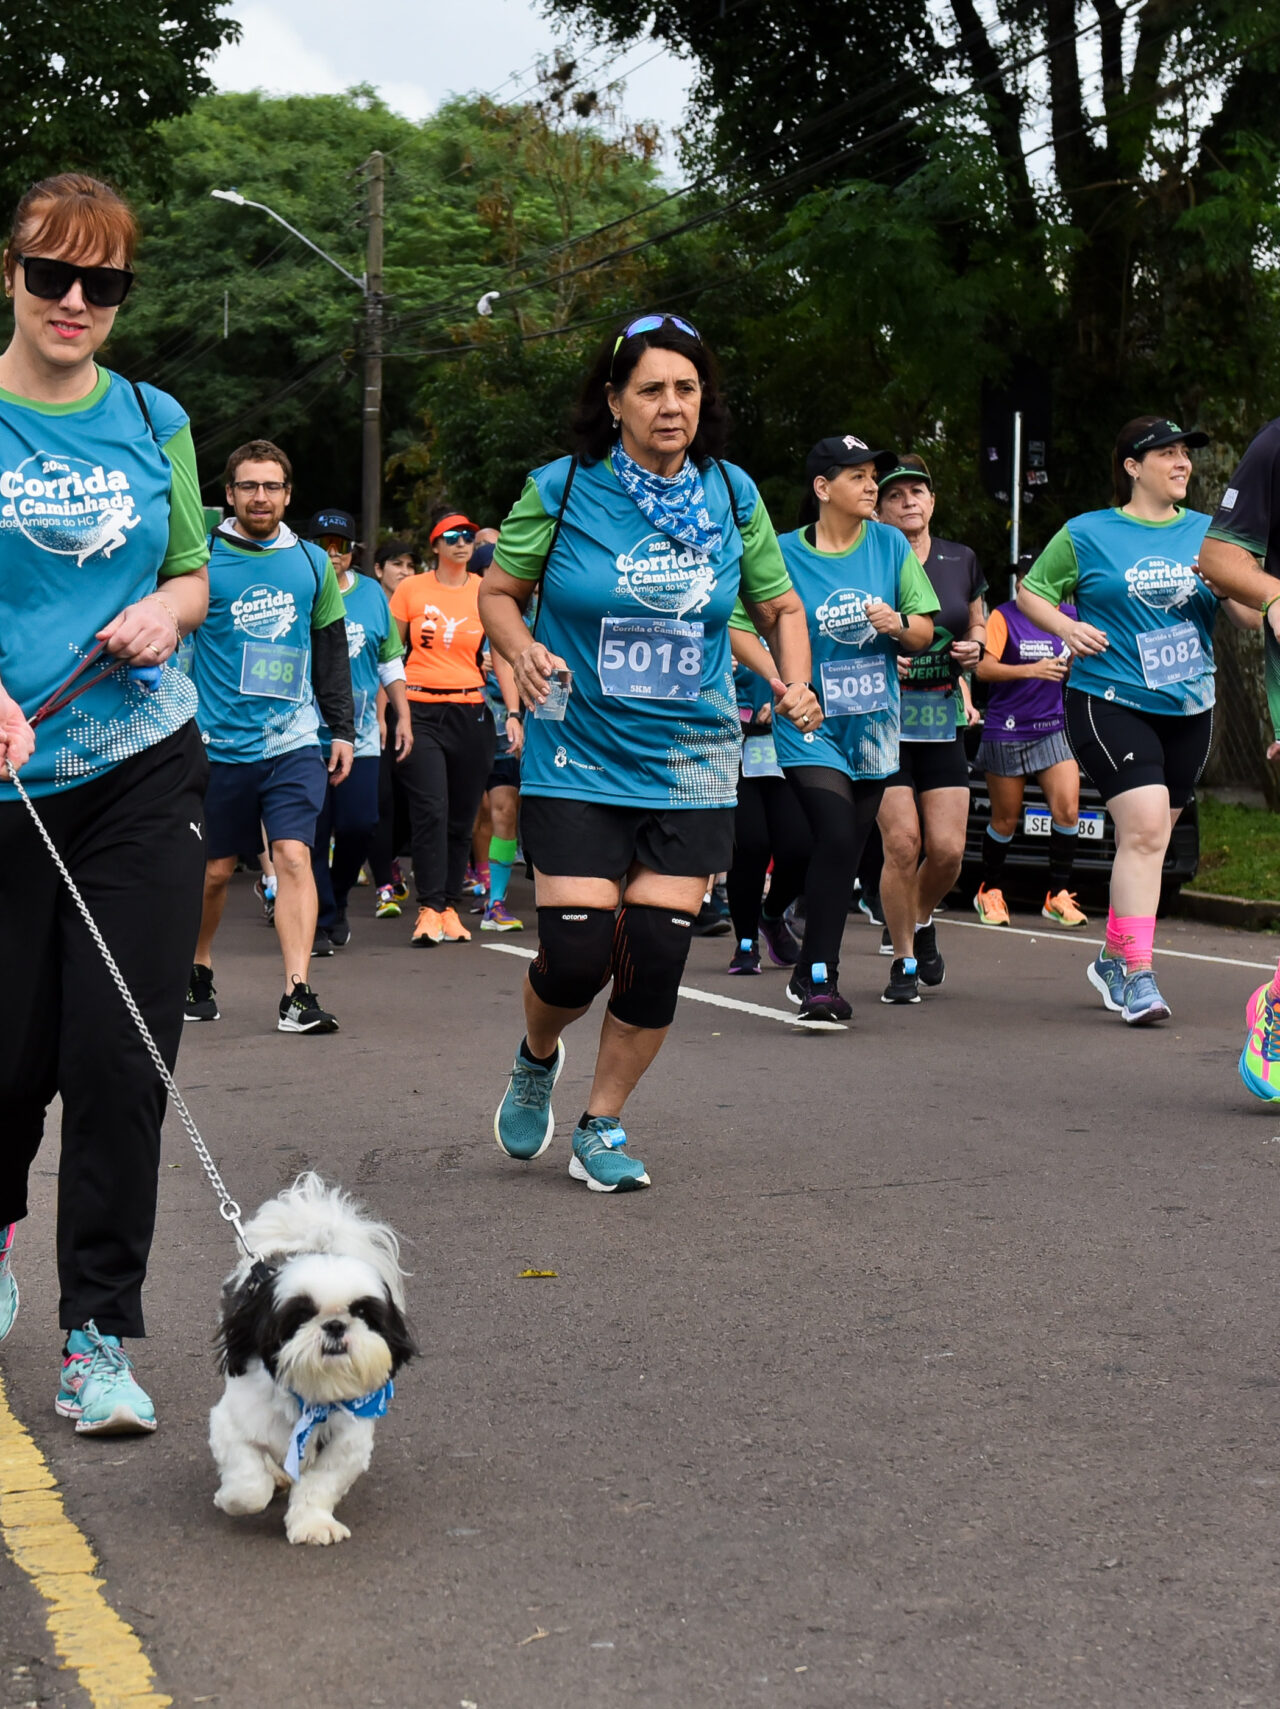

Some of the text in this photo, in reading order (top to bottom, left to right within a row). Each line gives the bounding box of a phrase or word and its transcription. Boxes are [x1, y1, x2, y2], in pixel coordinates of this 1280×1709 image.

[0, 466, 130, 499] Corrida
[2, 491, 135, 517] e Caminhada
[0, 516, 94, 528] dos Amigos do HC
[648, 541, 670, 552] 2023
[616, 547, 709, 572] Corrida
[618, 565, 715, 585] e Caminhada
[1125, 562, 1195, 582] Corrida
[615, 585, 631, 594] dos
[634, 585, 663, 594] Amigos
[677, 582, 688, 590] HC
[1136, 576, 1197, 590] Caminhada
[231, 590, 294, 616] Corrida
[242, 604, 296, 622] Caminhada
[827, 611, 868, 628] Caminh
[613, 625, 645, 633] Corrida
[654, 626, 702, 637] Caminhada
[603, 640, 701, 676] 5018
[1144, 637, 1200, 670] 5082
[251, 659, 294, 683] 498
[630, 685, 652, 694] 5KM
[827, 672, 885, 700] 5083
[904, 705, 948, 726] 285
[1032, 817, 1095, 835] SE86
